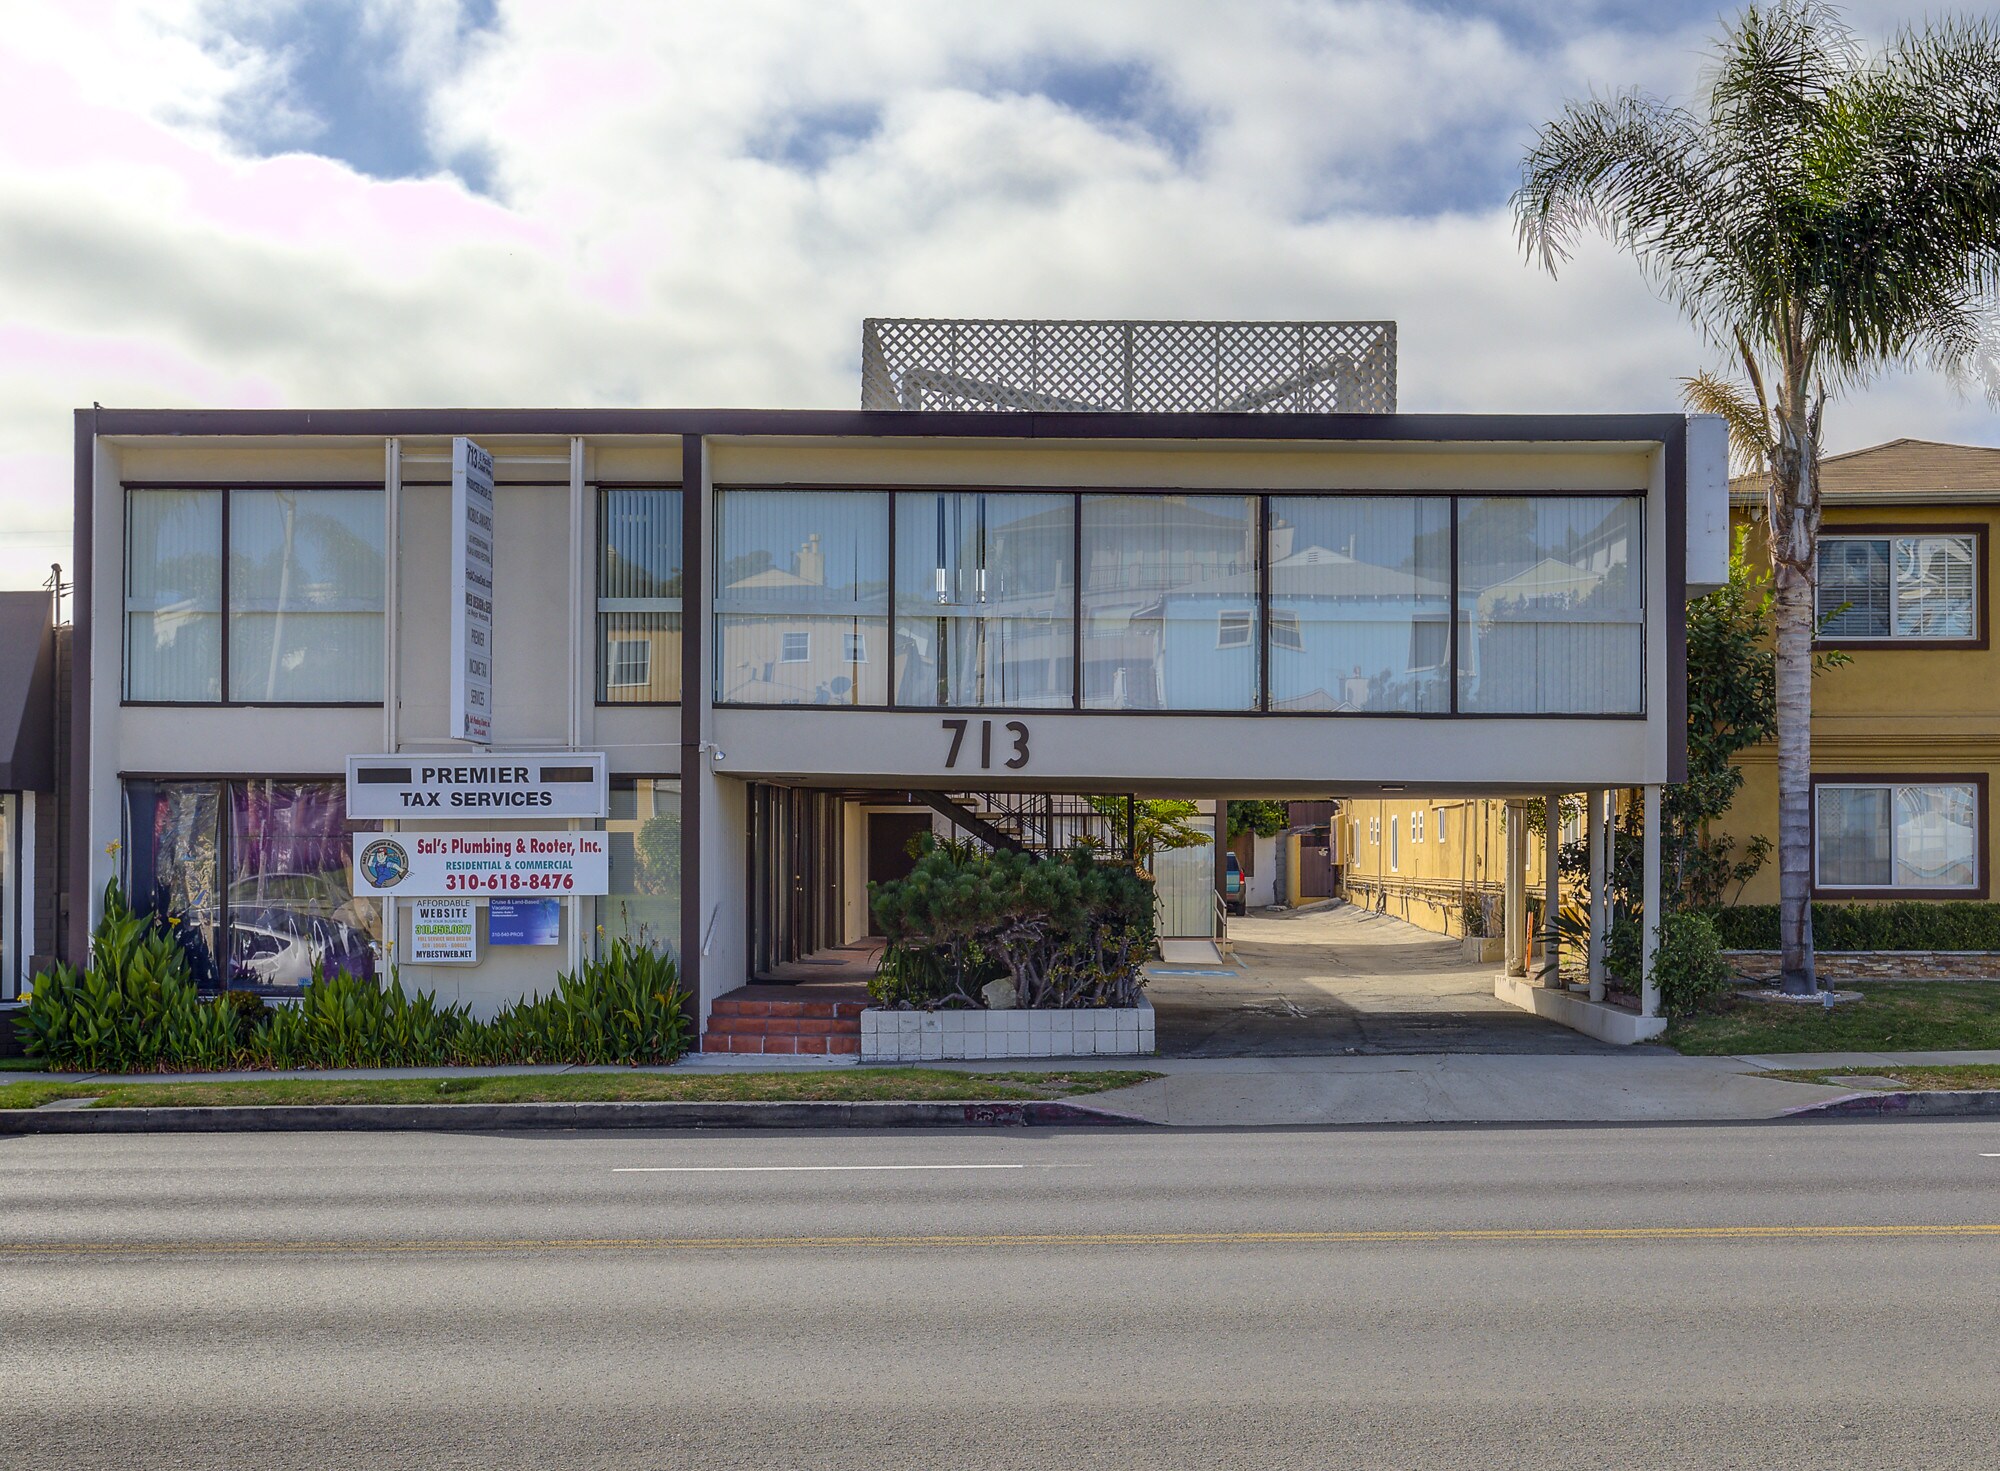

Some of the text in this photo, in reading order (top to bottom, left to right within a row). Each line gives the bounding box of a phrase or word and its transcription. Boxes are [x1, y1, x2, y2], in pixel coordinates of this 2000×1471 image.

[467, 444, 478, 468] 713
[471, 629, 484, 647] PREMIER
[471, 689, 485, 706] SERVICES
[942, 720, 1030, 769] 713
[422, 767, 529, 784] PREMIER
[400, 791, 552, 807] TAX SERVICES
[417, 837, 602, 858] Sal's Plumbing & Rooter, Inc.
[446, 860, 573, 870] RESIDENTIAL & COMMERCIAL
[446, 874, 574, 890] 310-618-8476
[420, 908, 468, 918] WEBSITE
